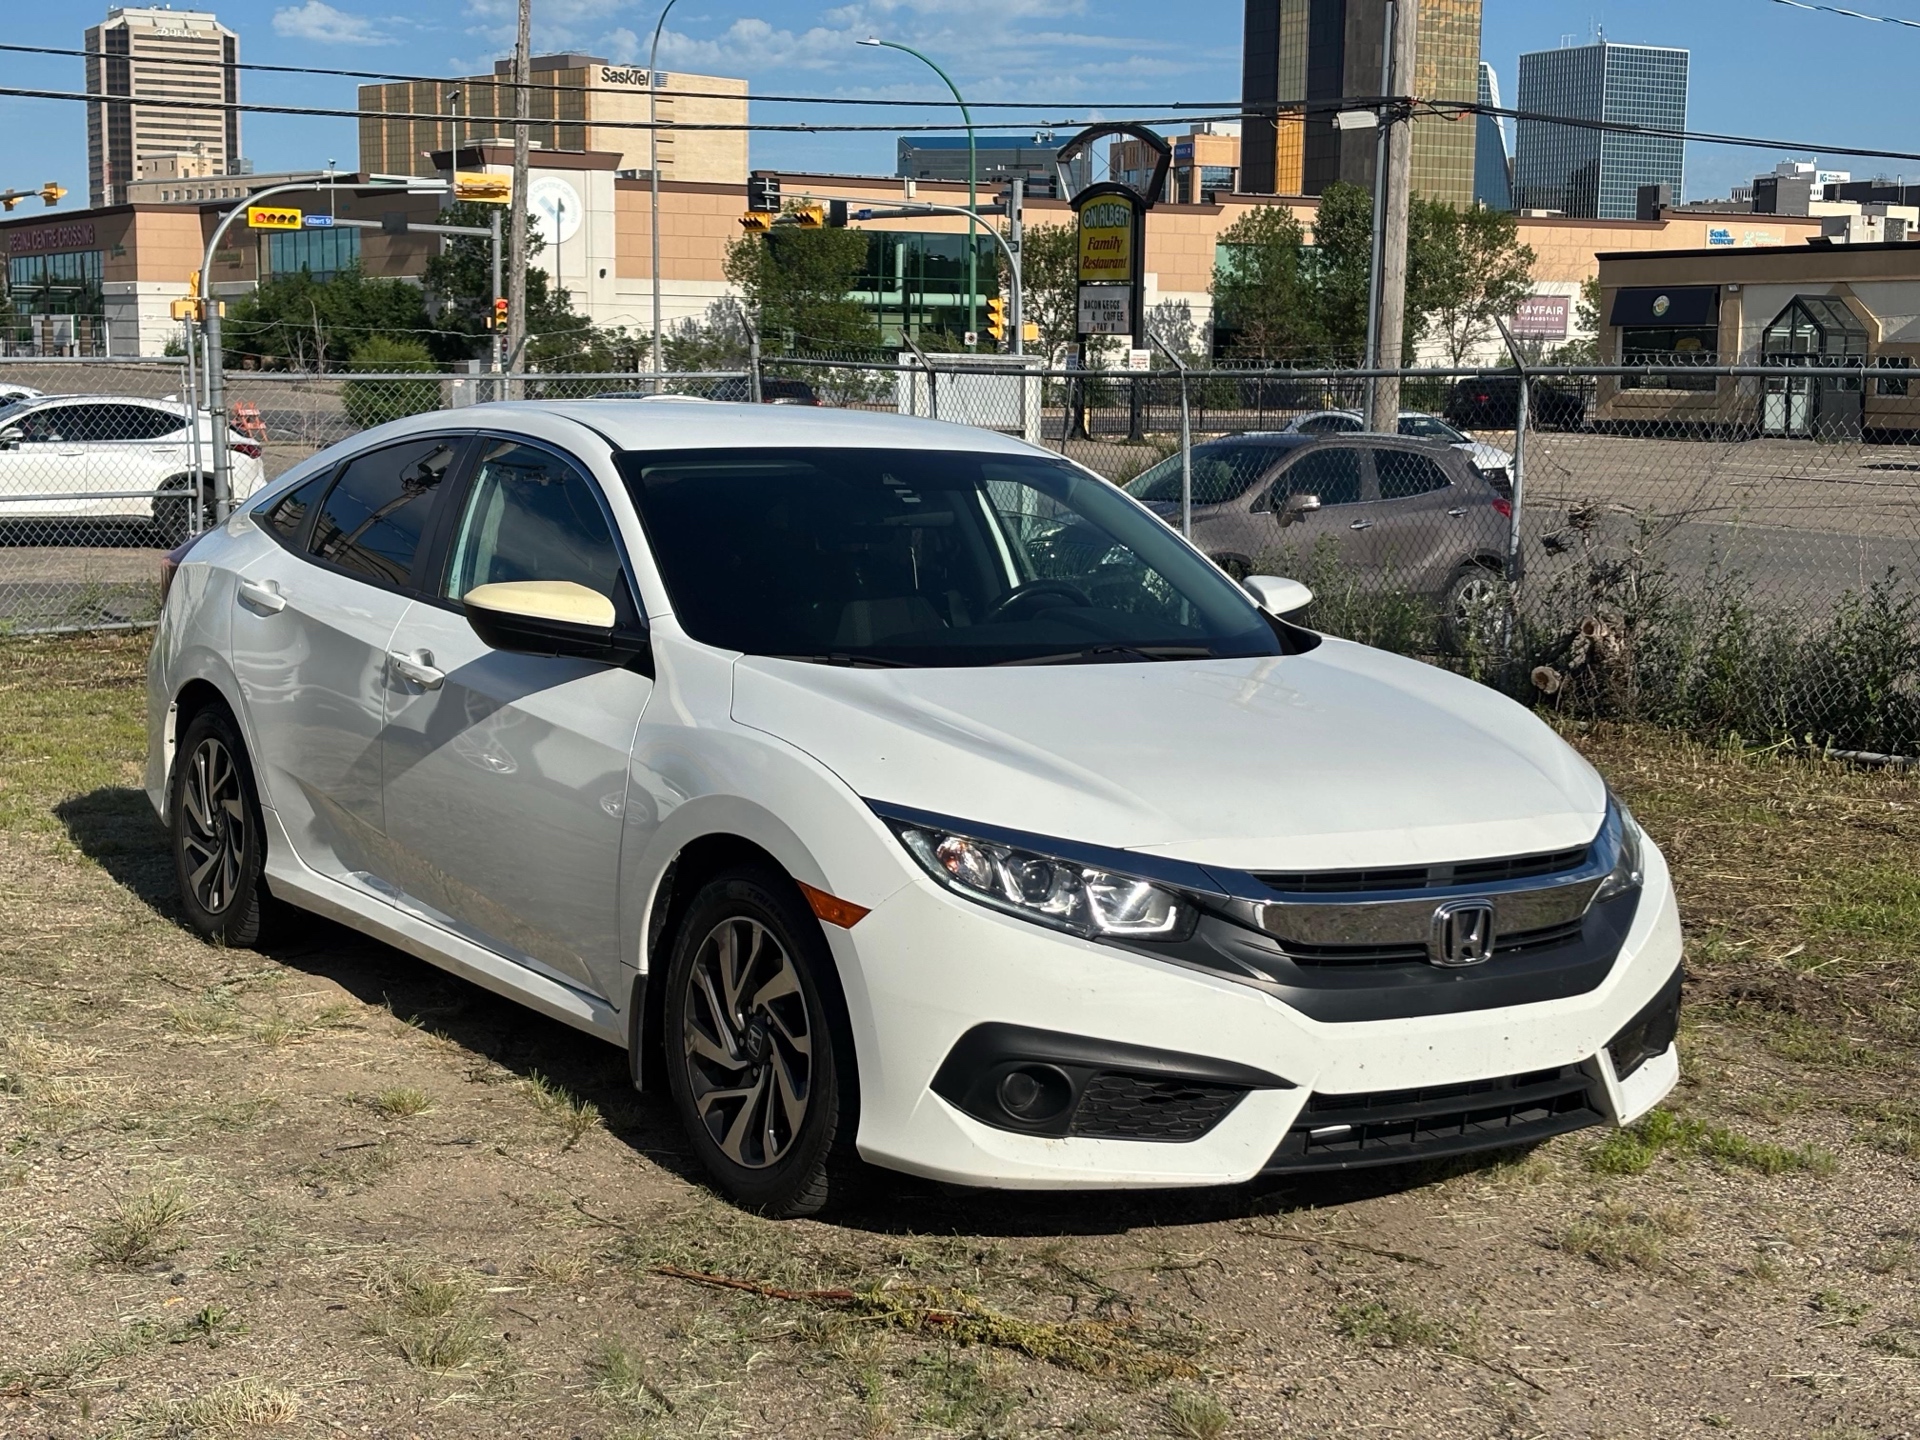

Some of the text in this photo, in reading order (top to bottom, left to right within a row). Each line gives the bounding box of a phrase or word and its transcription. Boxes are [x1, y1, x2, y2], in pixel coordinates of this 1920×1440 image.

[601, 67, 650, 86] SaskTel
[1084, 203, 1130, 229] ON ALBERT
[9, 224, 95, 251] REGINA CENTRE CROSSING
[1087, 236, 1123, 253] Family
[1082, 256, 1128, 270] Restaurant
[1103, 311, 1124, 321] COFFEE
